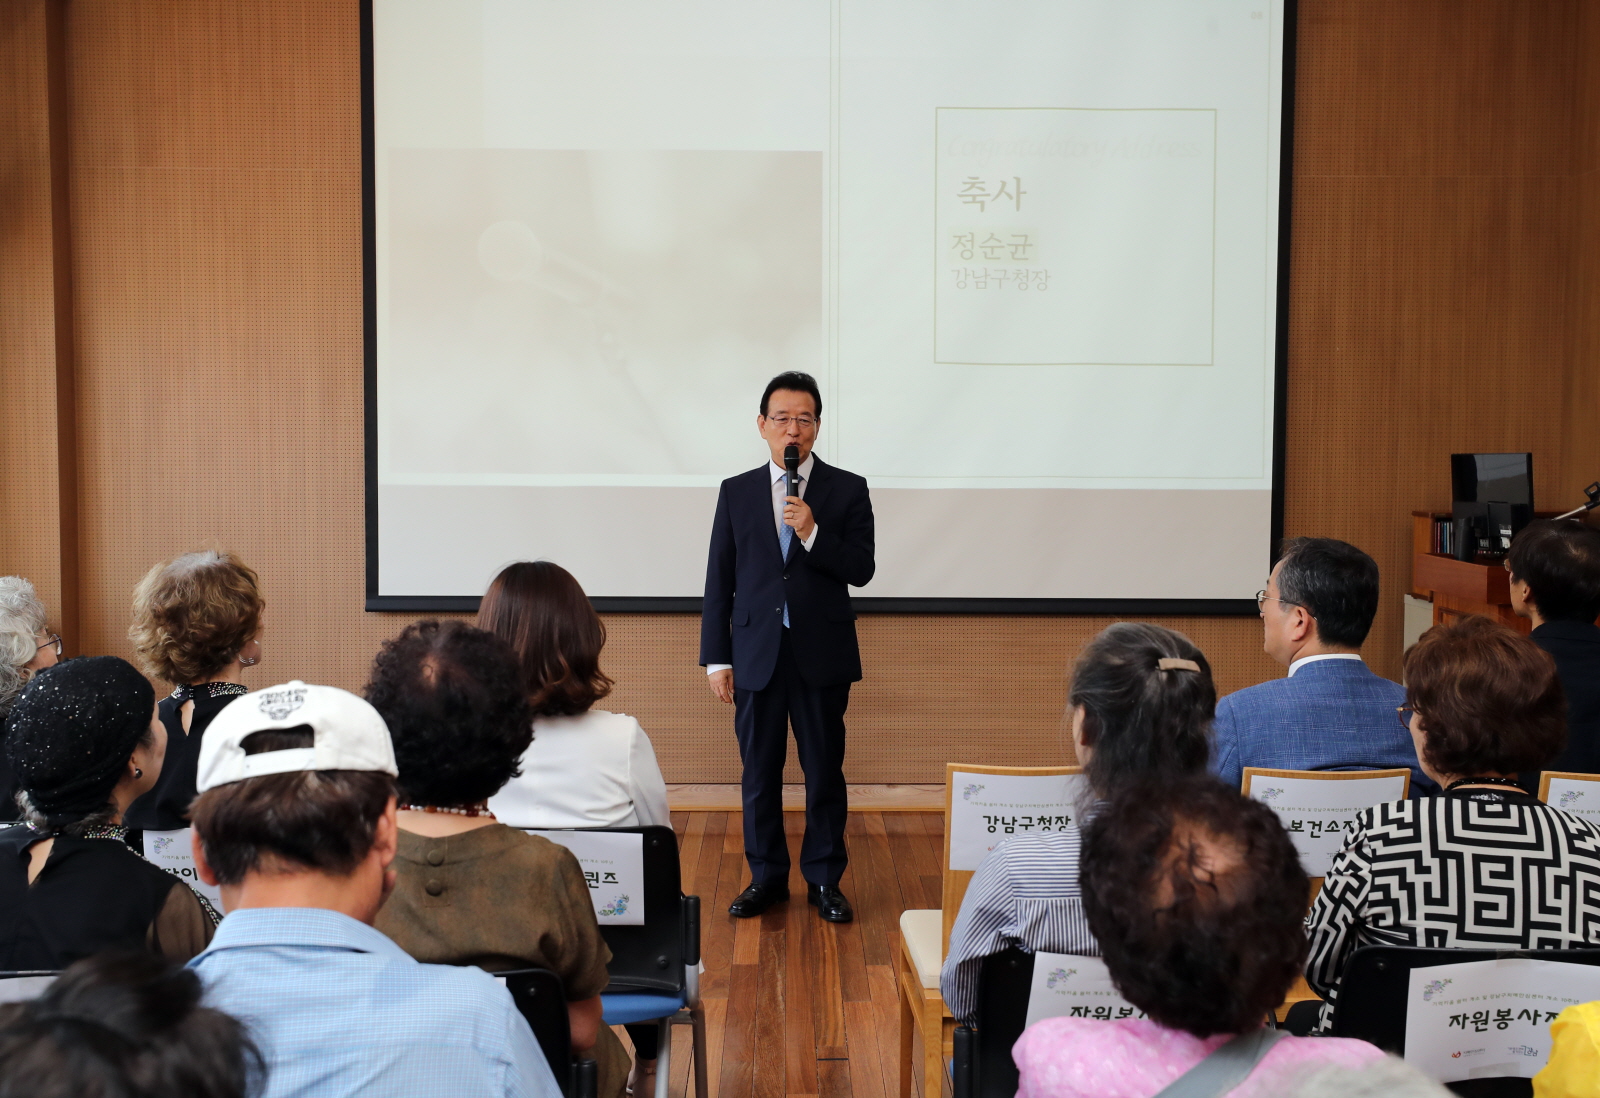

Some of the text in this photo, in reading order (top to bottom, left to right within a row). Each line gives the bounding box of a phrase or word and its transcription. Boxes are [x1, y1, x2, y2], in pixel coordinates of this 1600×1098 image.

[956, 176, 1028, 213] 축사
[951, 231, 1034, 262] 정순균
[951, 267, 1052, 292] 강남구청장
[983, 815, 1072, 834] 강남구청장
